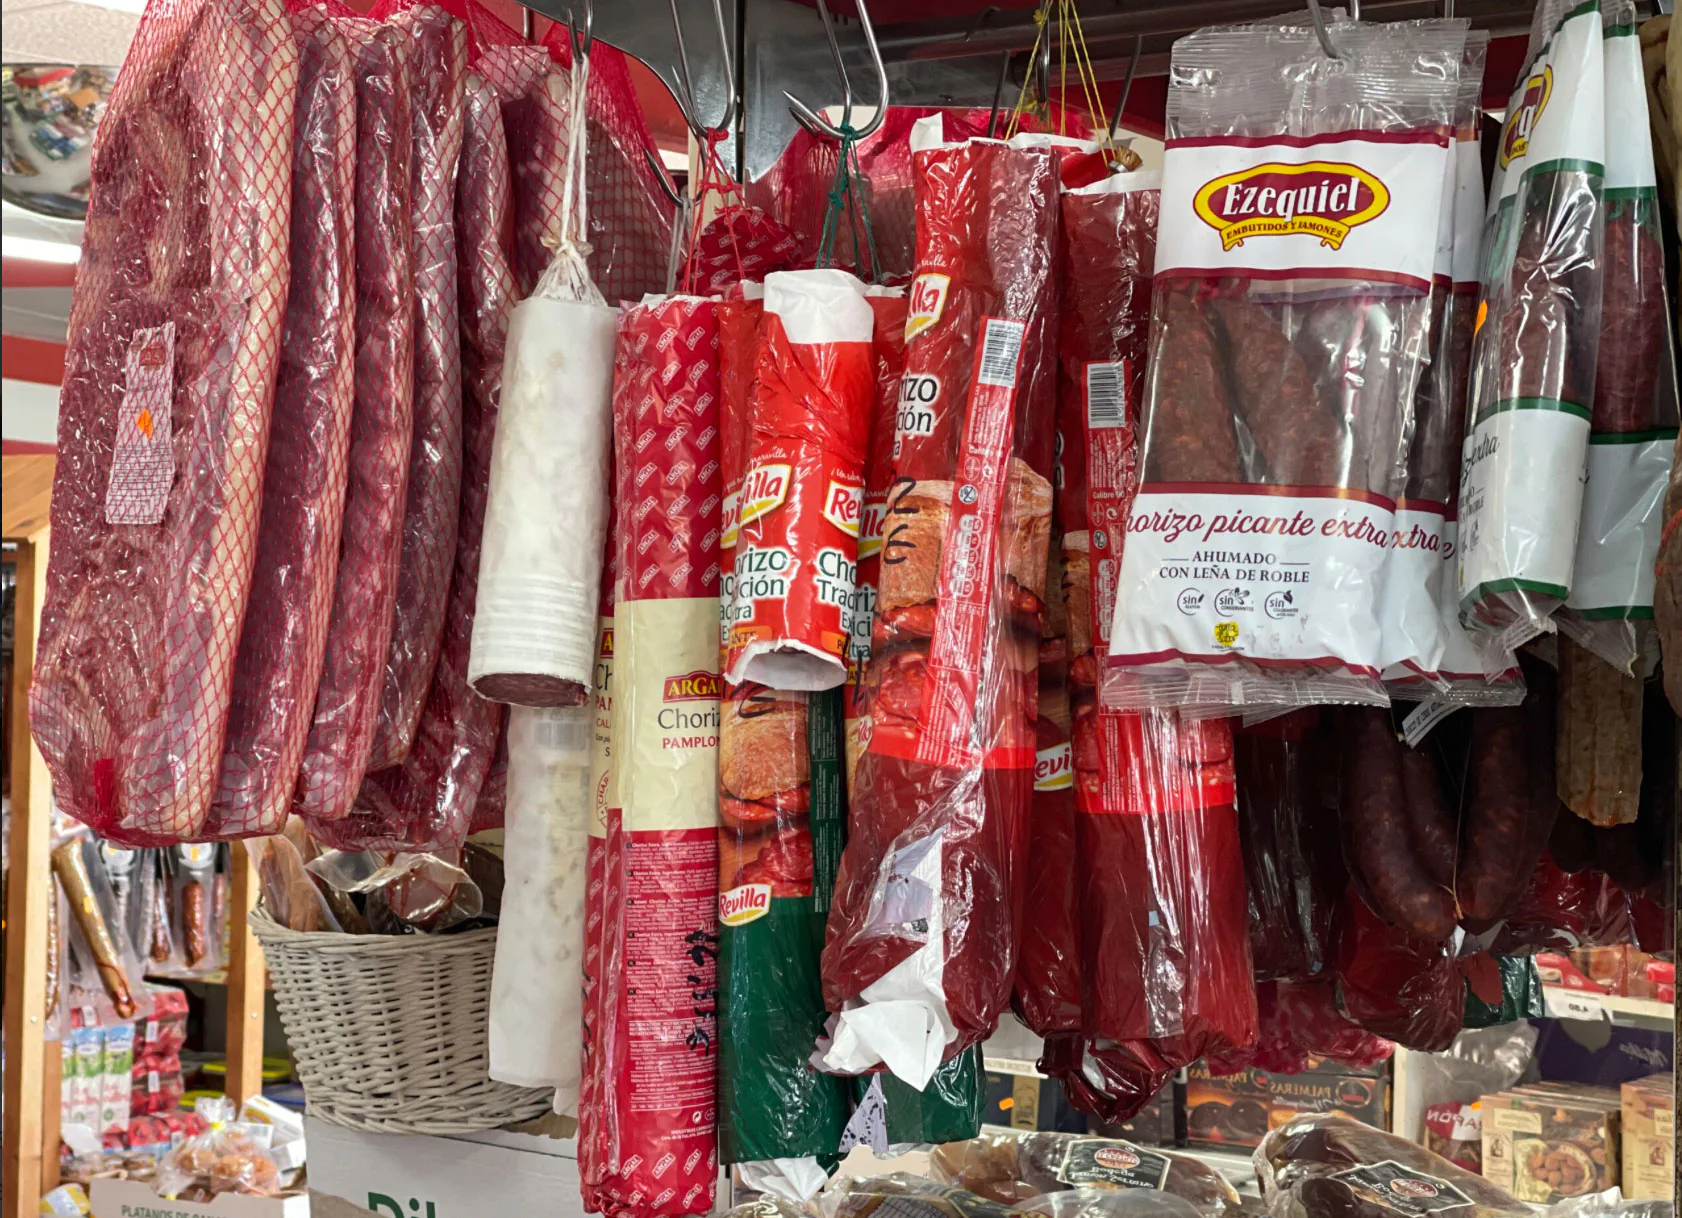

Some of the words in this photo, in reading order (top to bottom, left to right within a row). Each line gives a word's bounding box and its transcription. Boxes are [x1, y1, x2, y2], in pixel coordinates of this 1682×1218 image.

[1222, 176, 1360, 222] Ezequiel
[1226, 222, 1288, 240] EMBUTIDOS
[1289, 221, 1297, 230] Y
[1298, 221, 1343, 239] JAMONES
[1092, 490, 1115, 499] Calibre
[1201, 509, 1316, 543] picante
[1320, 516, 1389, 549] extra
[1191, 550, 1277, 566] AHUMADO
[1159, 566, 1190, 580] CON
[1193, 564, 1230, 581] LEÑA
[1235, 569, 1256, 582] DE
[1260, 570, 1310, 584] ROBLE
[1182, 594, 1197, 605] sin
[1219, 595, 1234, 606] sin
[1269, 598, 1285, 608] sin
[719, 885, 767, 918] Revilla
